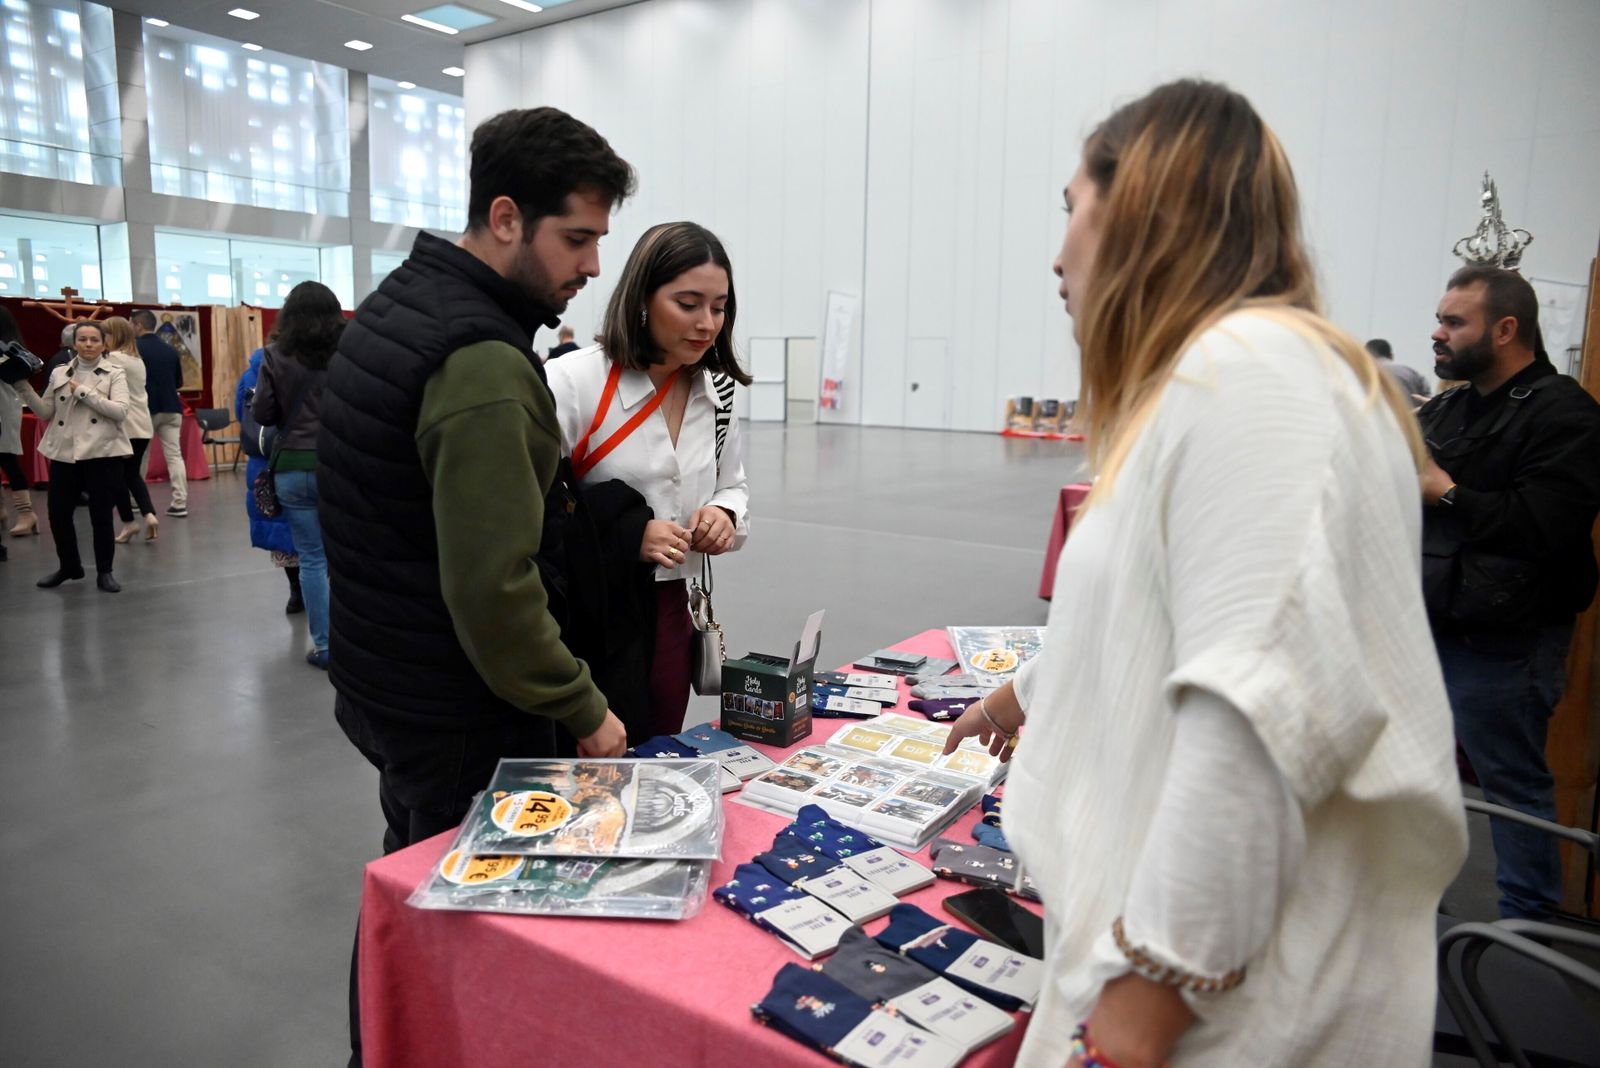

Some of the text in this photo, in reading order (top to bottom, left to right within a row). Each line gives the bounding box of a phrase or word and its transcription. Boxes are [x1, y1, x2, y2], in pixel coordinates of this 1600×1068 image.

[745, 675, 760, 687] Holy
[744, 684, 762, 694] Cards
[672, 793, 691, 817] Cards
